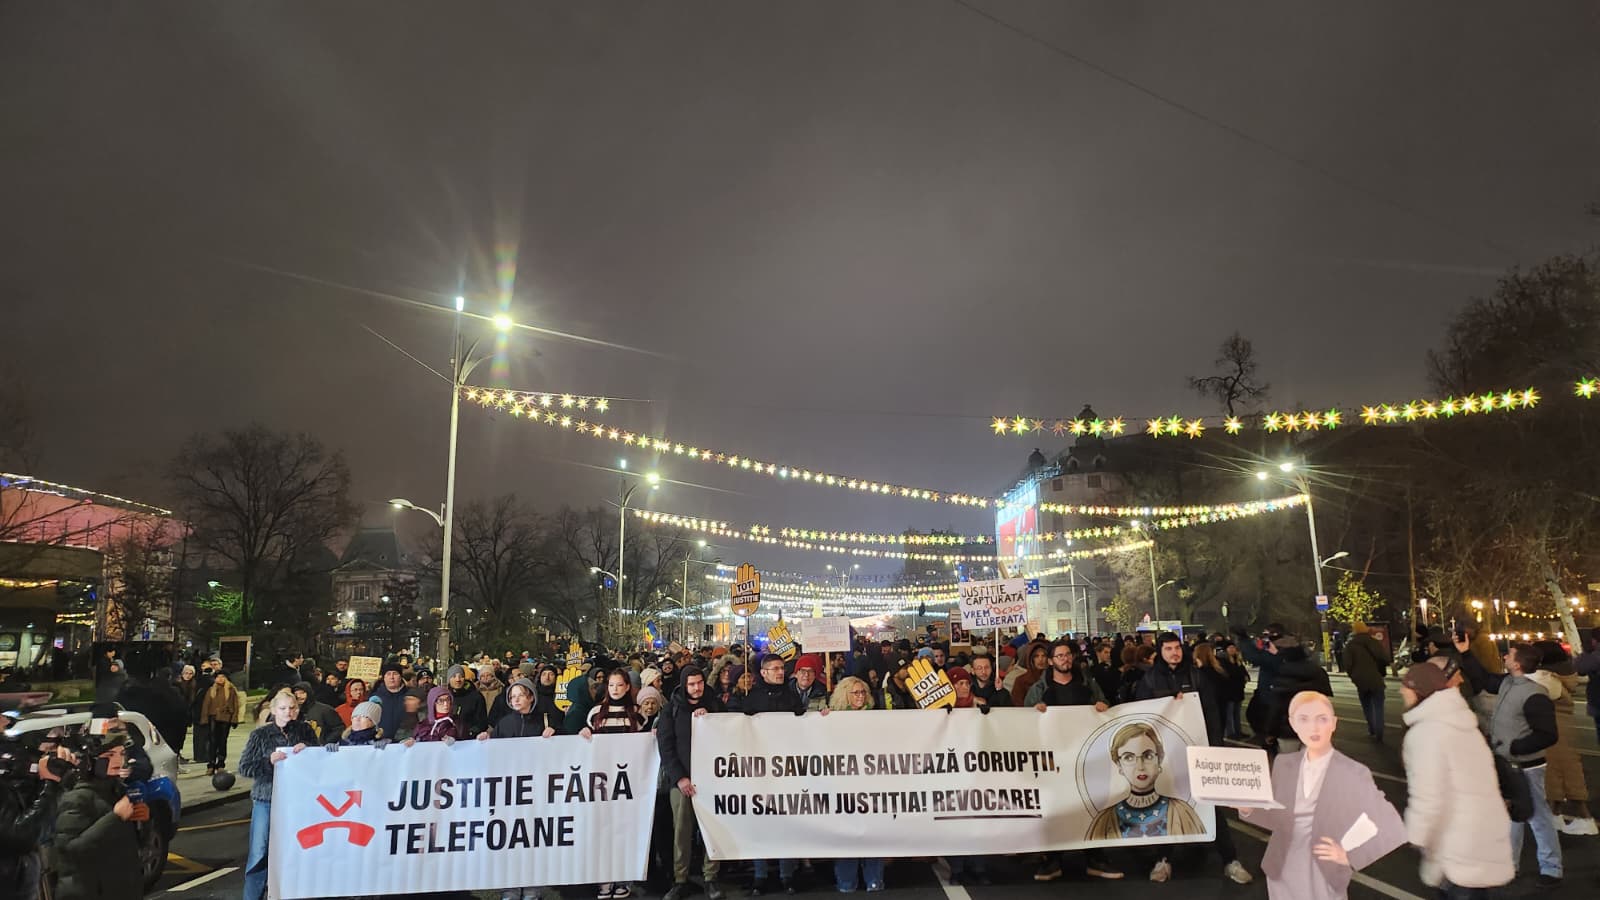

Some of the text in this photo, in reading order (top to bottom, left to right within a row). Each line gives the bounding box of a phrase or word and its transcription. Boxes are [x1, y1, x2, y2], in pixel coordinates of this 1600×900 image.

[963, 609, 990, 619] VREM
[714, 748, 1060, 778] CÂND SAVONEA SALVEAZĂ CORUPȚII,
[1195, 758, 1222, 773] Asigur
[388, 763, 634, 816] JUSTIȚIE FĂRĂ
[1201, 775, 1230, 787] pentru
[714, 789, 1041, 820] NOI SALVĂM JUSTIȚIA! REVOCARE!
[385, 816, 575, 855] TELEFOANE
